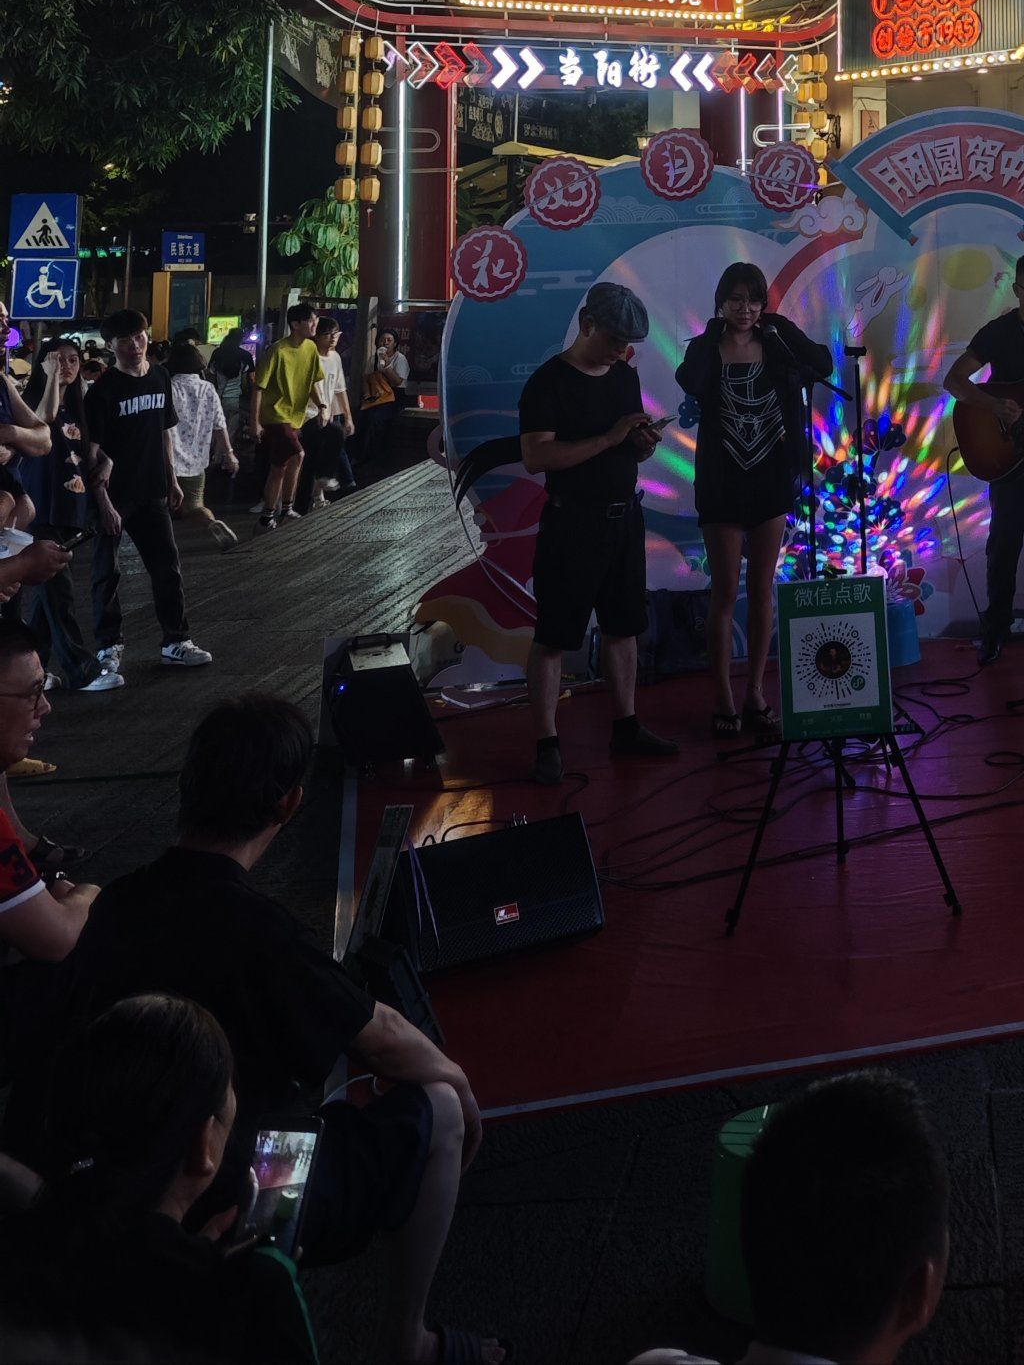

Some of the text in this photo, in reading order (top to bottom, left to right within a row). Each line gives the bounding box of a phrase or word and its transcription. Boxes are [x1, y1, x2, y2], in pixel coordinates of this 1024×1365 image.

[878, 18, 975, 54] 创始于1945
[557, 45, 661, 89] 当阳街
[540, 171, 588, 210] 好
[170, 242, 200, 257] 民族大道
[794, 582, 873, 608] 微信点歌
